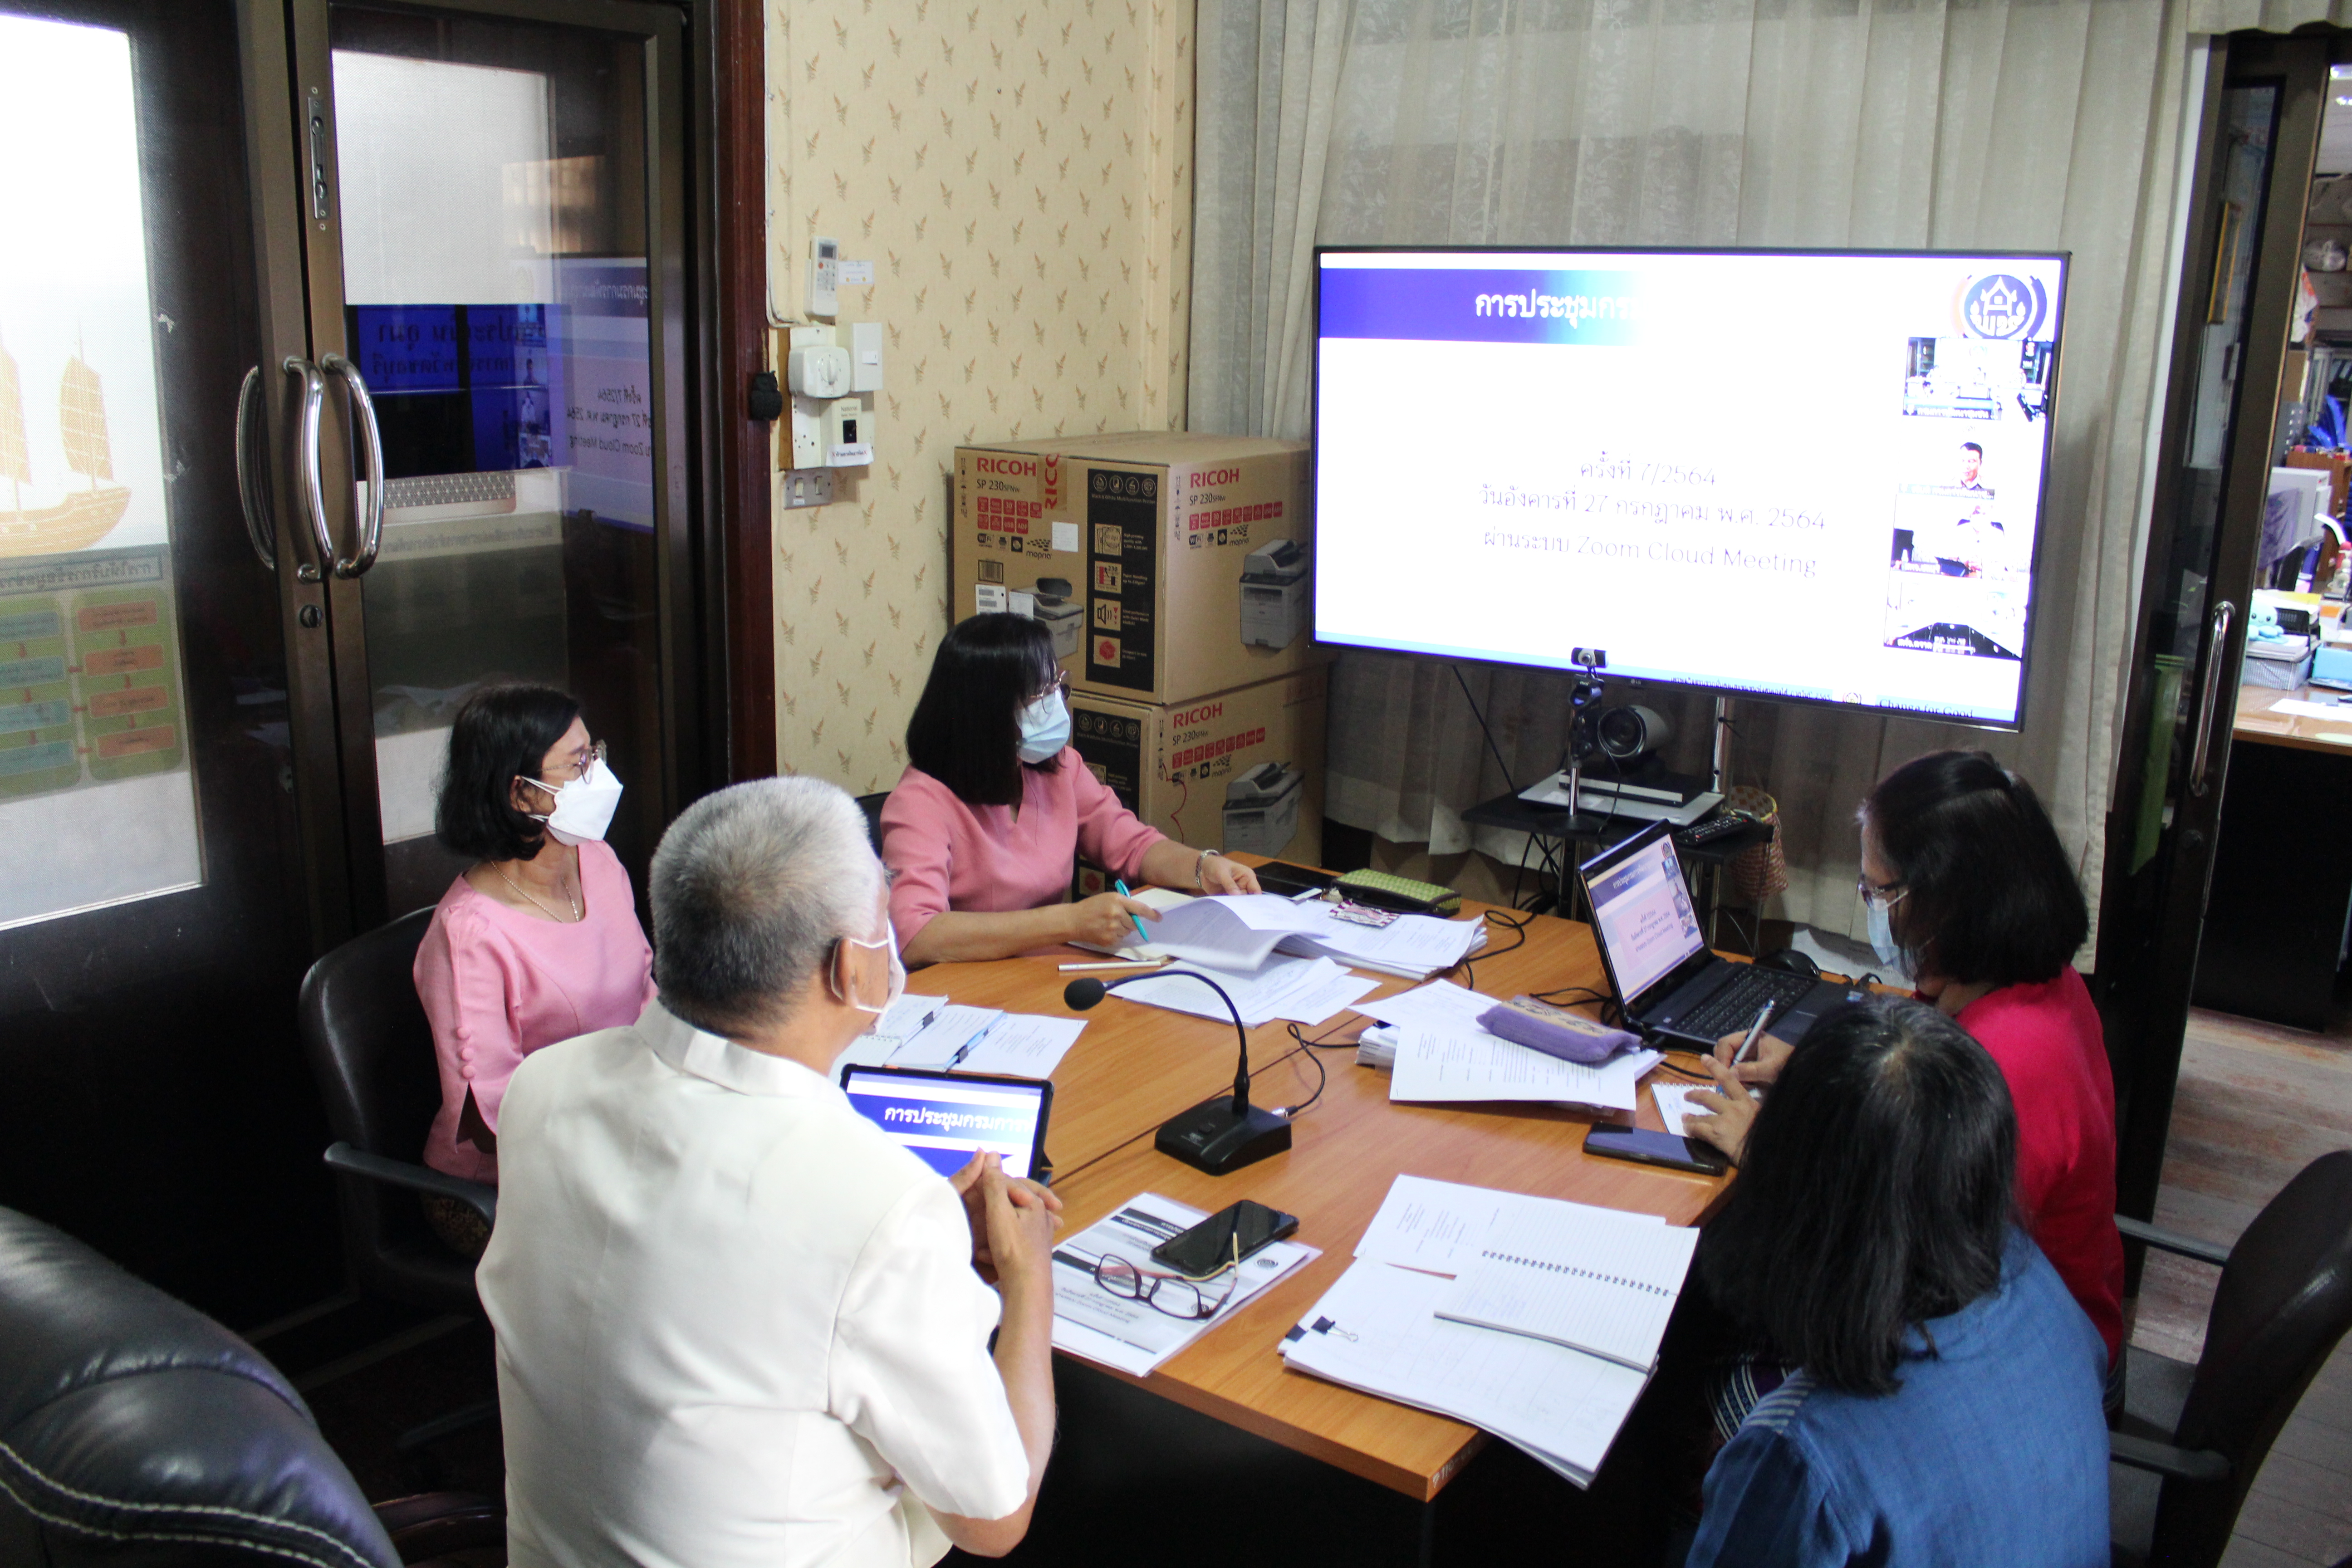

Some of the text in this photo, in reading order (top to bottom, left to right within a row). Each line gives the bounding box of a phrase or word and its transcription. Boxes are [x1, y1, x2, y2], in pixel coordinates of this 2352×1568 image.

[977, 457, 1036, 476] RICOH
[1581, 451, 1716, 486] ครั้งที่ 7/2564
[977, 479, 986, 489] SP
[1191, 468, 1240, 489] RICOH
[1190, 495, 1198, 506] SP
[1479, 483, 1825, 530] วันอังคารที่ 27 กรกฎาคม พ.ศ. 2564
[1026, 550, 1051, 560] mopria
[1485, 525, 1816, 578] ผ่านระบบ Zoom Cloud Meeting
[1173, 702, 1222, 729] RICOH
[1879, 699, 1973, 718] Change for Good
[1173, 735, 1181, 746] SP
